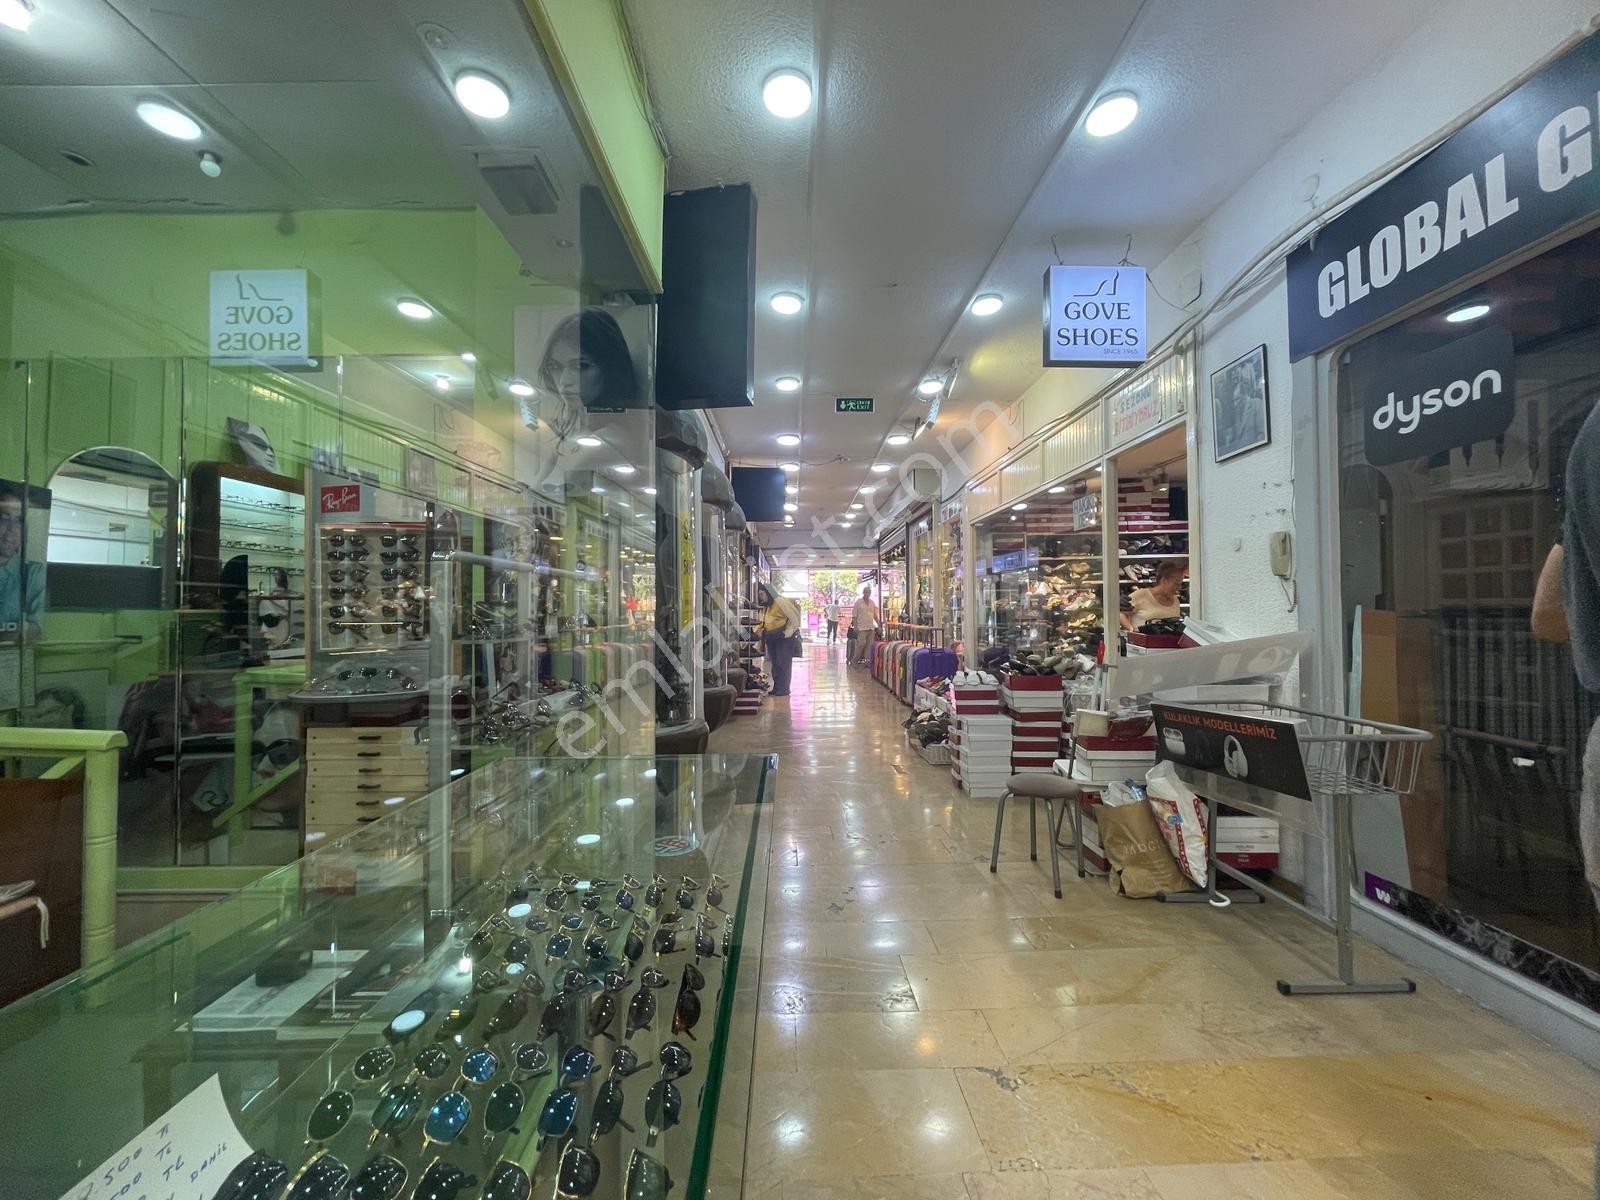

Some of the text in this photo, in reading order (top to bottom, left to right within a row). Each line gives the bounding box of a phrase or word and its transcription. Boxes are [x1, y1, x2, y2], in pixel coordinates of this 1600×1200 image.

[1317, 90, 1600, 319] GLOBAL G
[1064, 302, 1131, 320] GOVE
[1056, 327, 1139, 346] SHOES
[1373, 369, 1502, 434] dyson
[1163, 711, 1277, 740] KULAKLIK MODELLERİMİZ
[162, 1155, 184, 1182] TL
